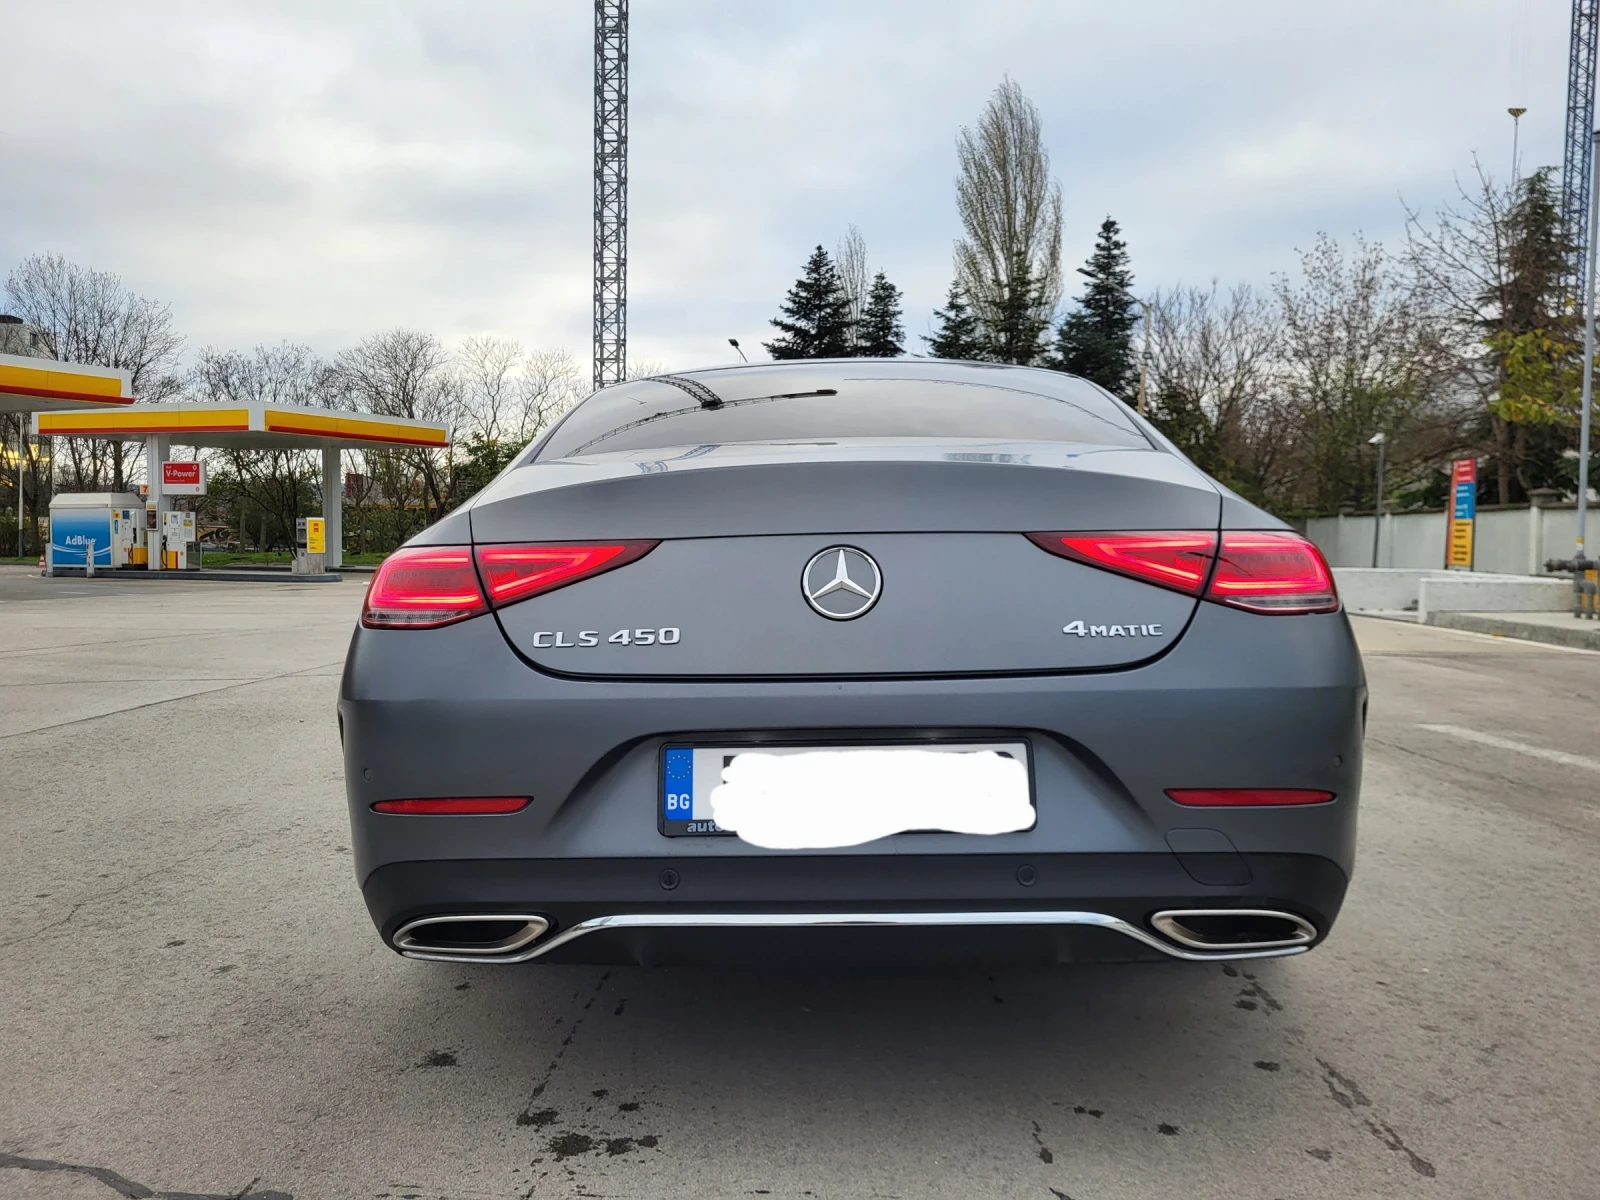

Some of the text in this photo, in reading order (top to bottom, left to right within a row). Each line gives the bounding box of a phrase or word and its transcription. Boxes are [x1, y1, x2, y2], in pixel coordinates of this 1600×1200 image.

[165, 469, 196, 478] V-Power
[65, 535, 96, 546] AdBlue
[1062, 620, 1164, 637] 4MATIC
[533, 627, 681, 648] CLS 450
[667, 793, 690, 810] BG
